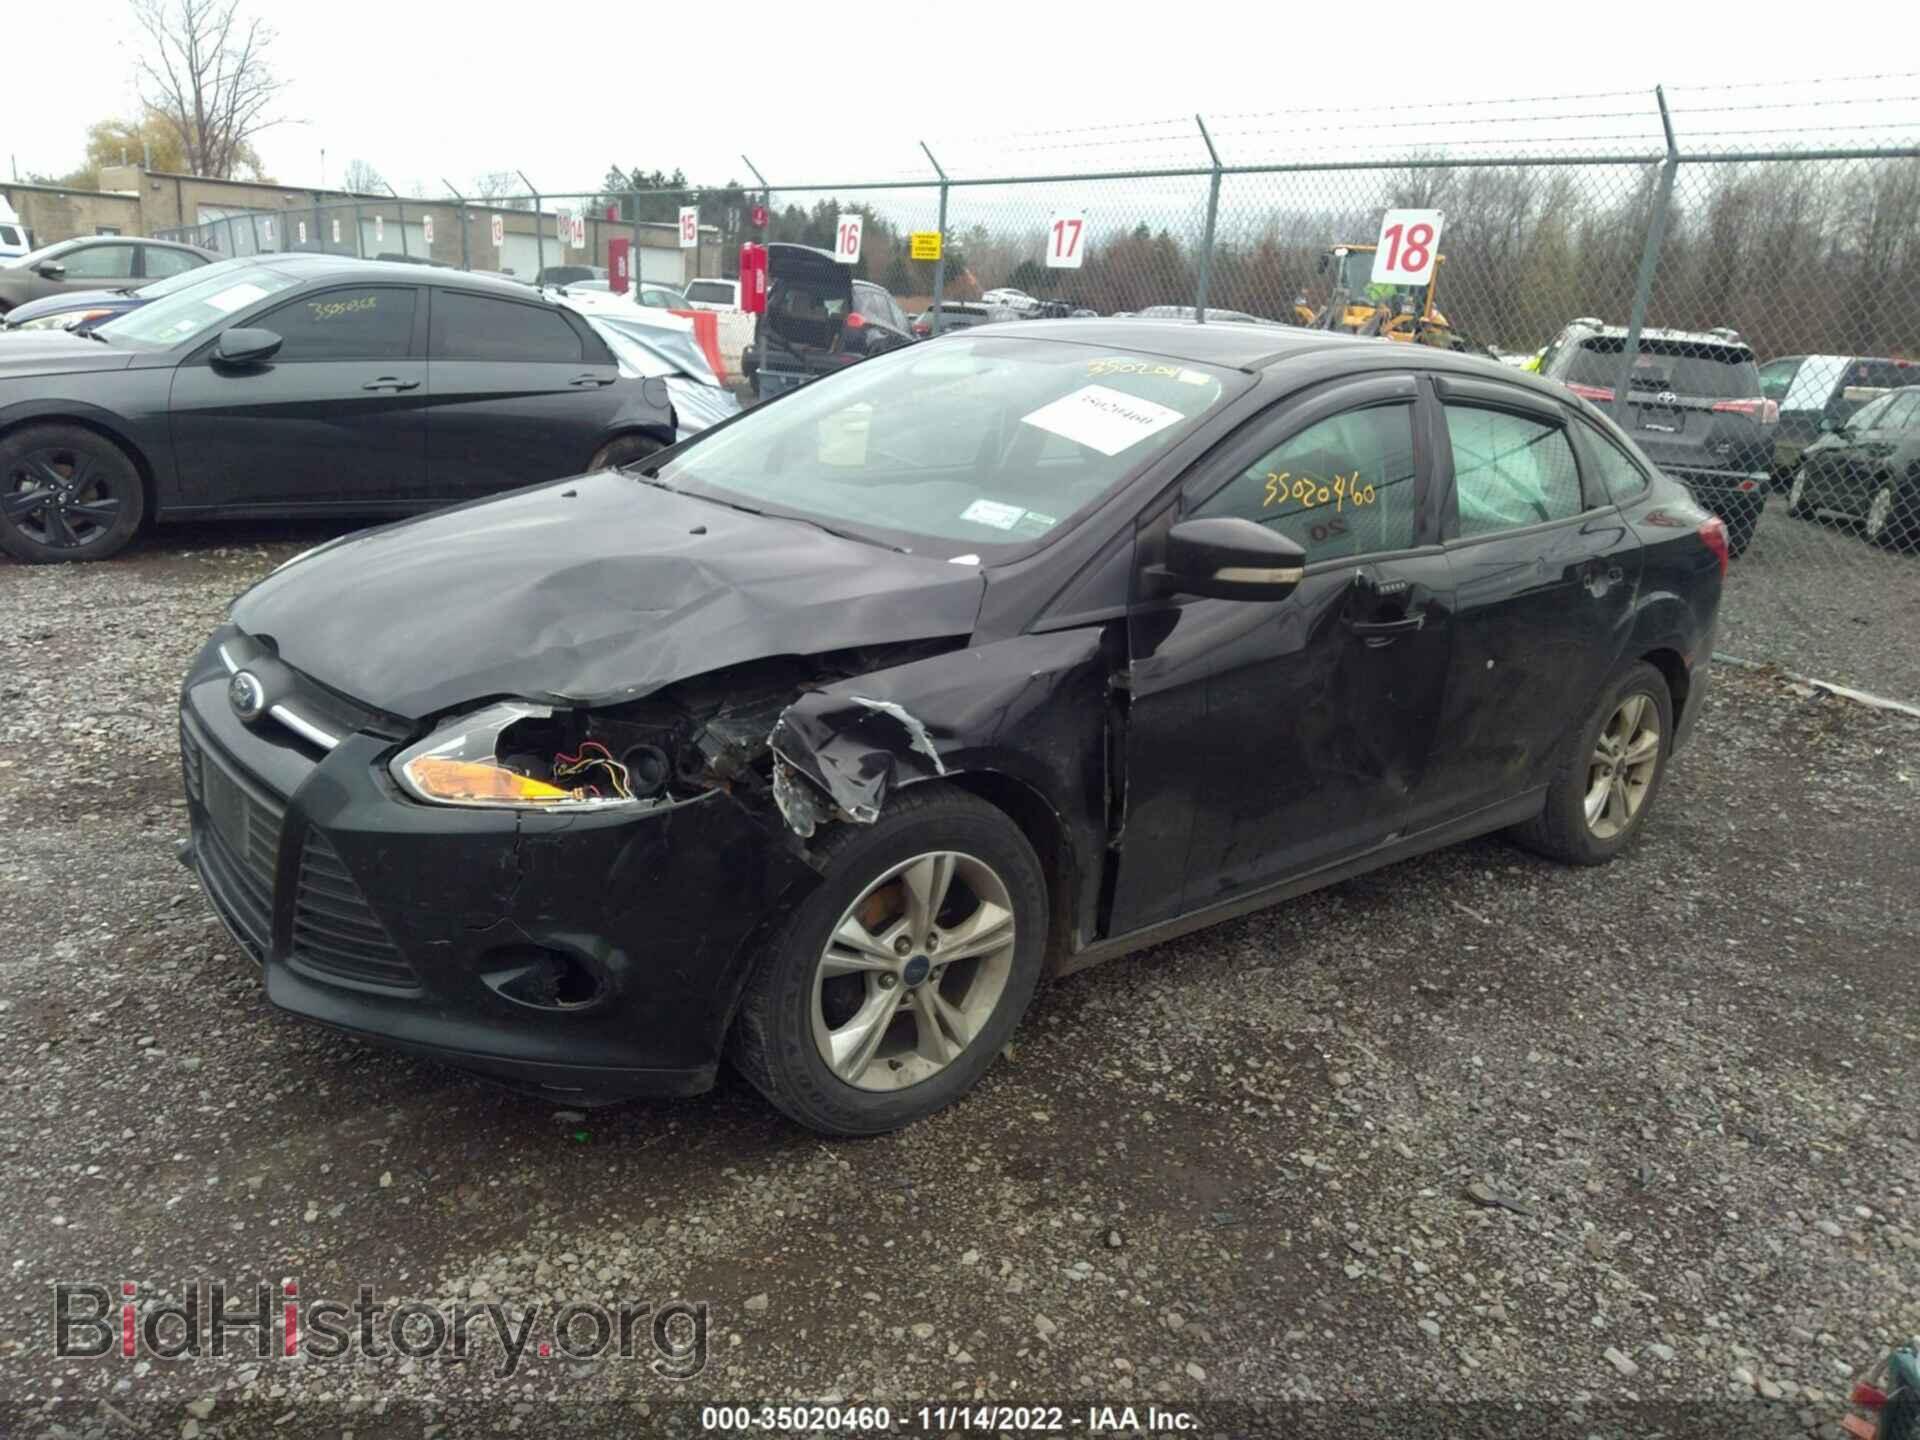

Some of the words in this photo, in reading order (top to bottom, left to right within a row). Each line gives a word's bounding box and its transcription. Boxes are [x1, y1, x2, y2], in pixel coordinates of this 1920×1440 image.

[571, 218, 583, 241] 14
[681, 215, 696, 241] 15
[840, 223, 859, 255] 16
[1053, 218, 1083, 259] 17
[1383, 222, 1436, 273] 18
[1263, 470, 1377, 513] 35020460
